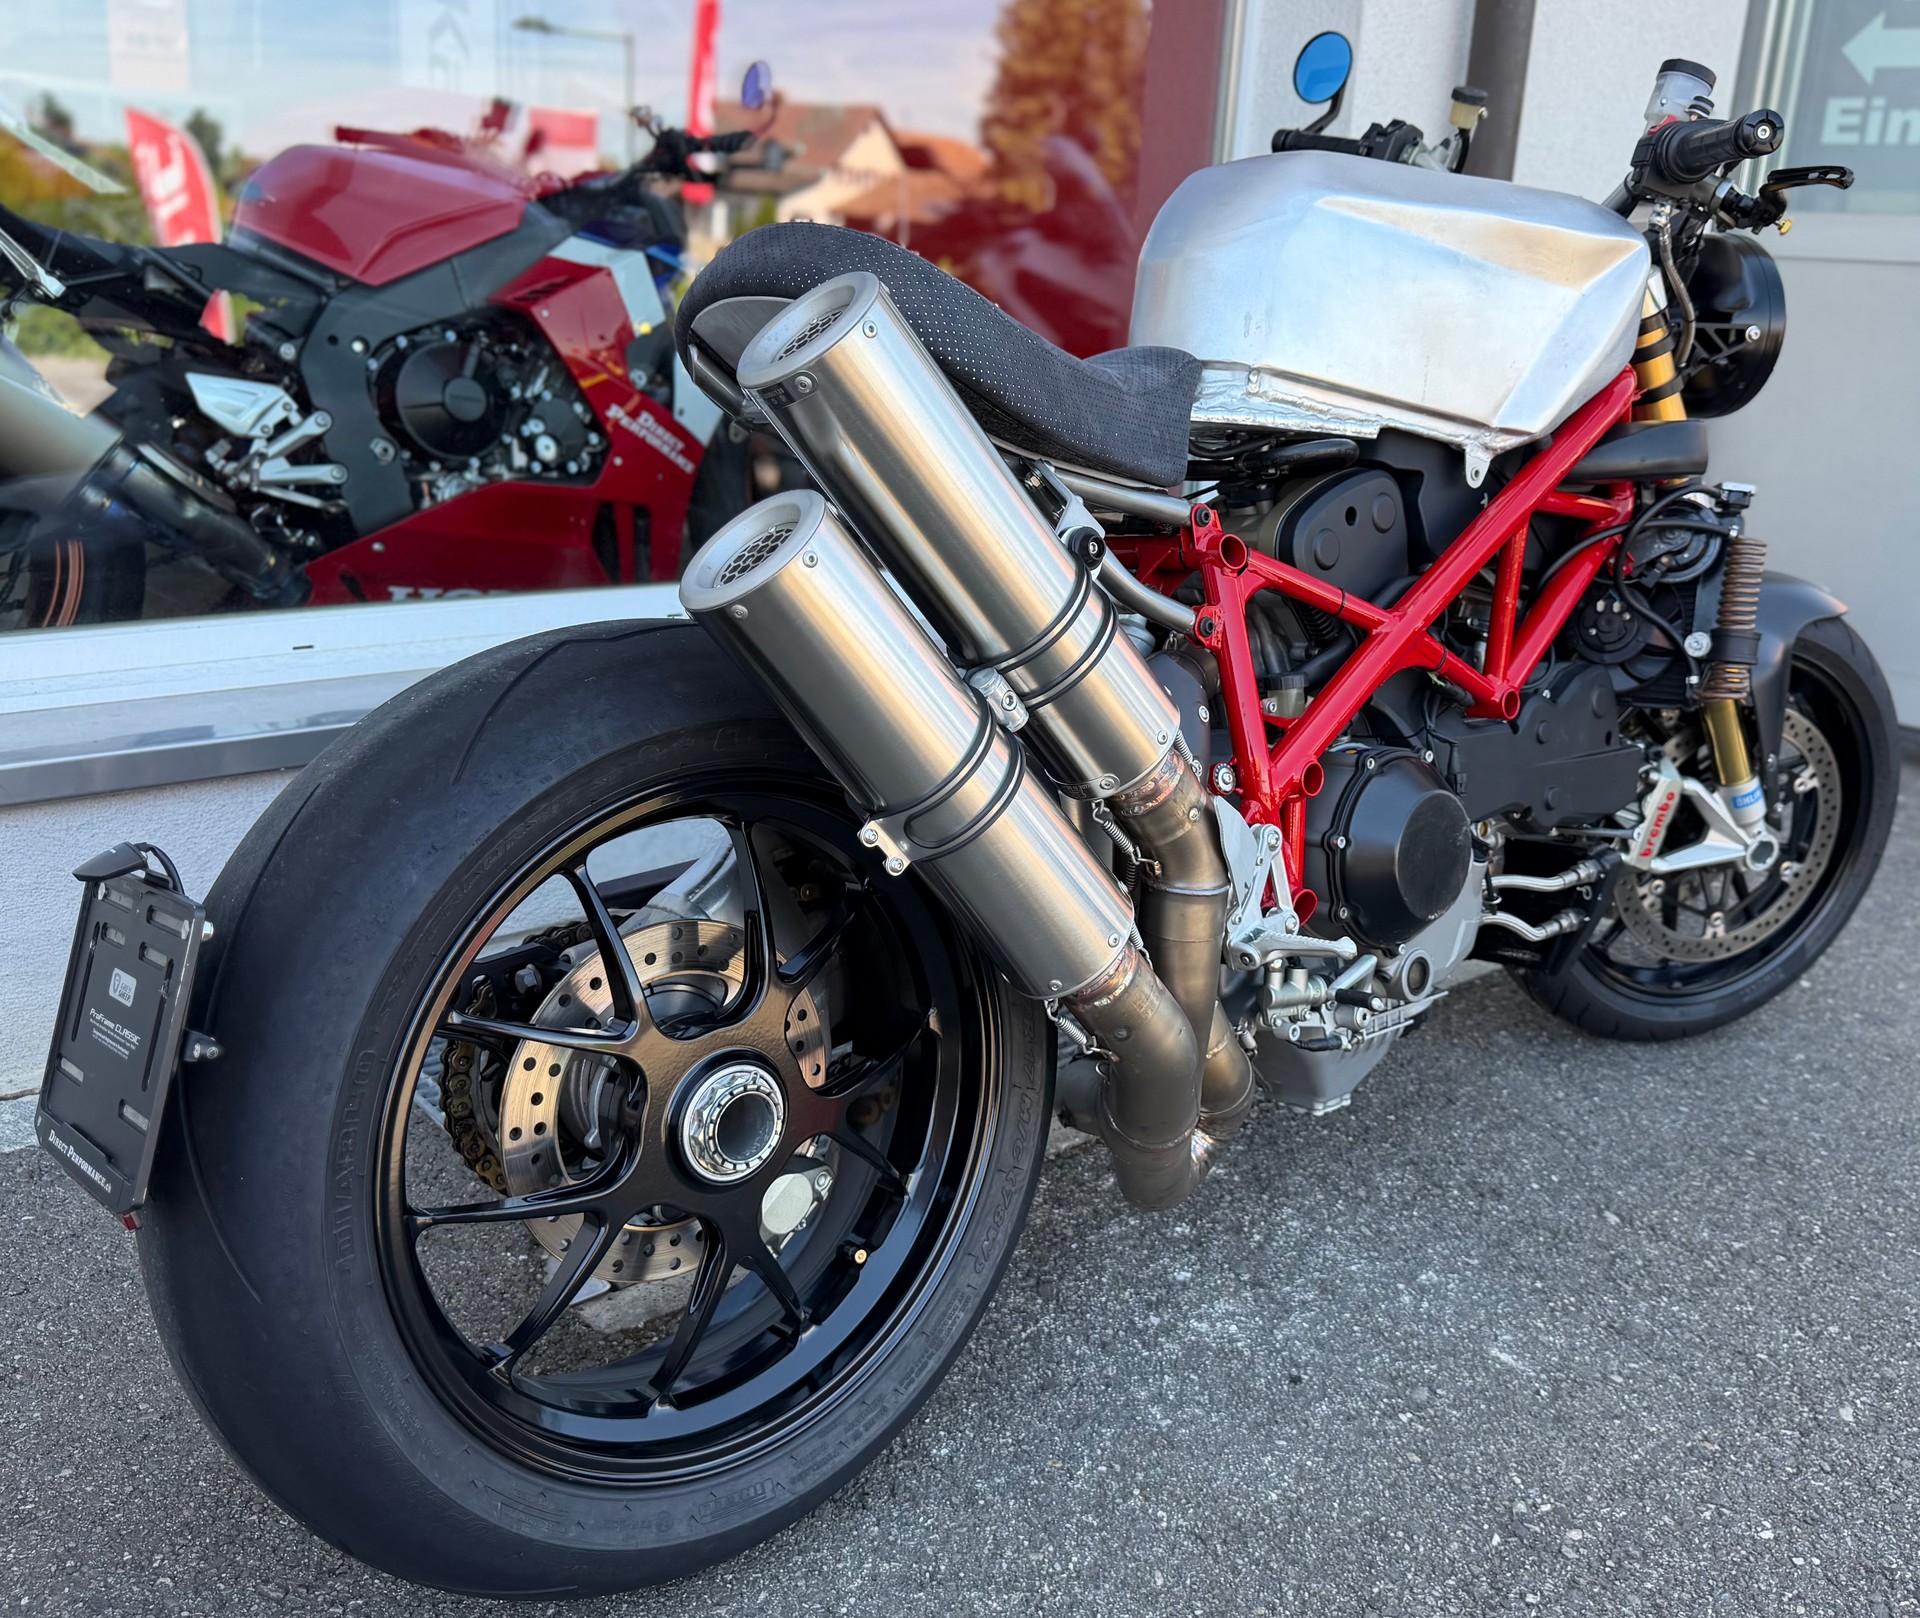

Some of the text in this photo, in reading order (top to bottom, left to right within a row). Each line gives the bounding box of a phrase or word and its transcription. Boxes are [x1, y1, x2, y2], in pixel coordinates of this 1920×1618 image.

[1821, 98, 1920, 145] Ein
[636, 409, 686, 452] DIRECT
[1639, 791, 1676, 858] brembo
[89, 1007, 116, 1030] ProFrame
[114, 1023, 142, 1046] CLASSIC
[48, 1129, 69, 1154] DIRECT
